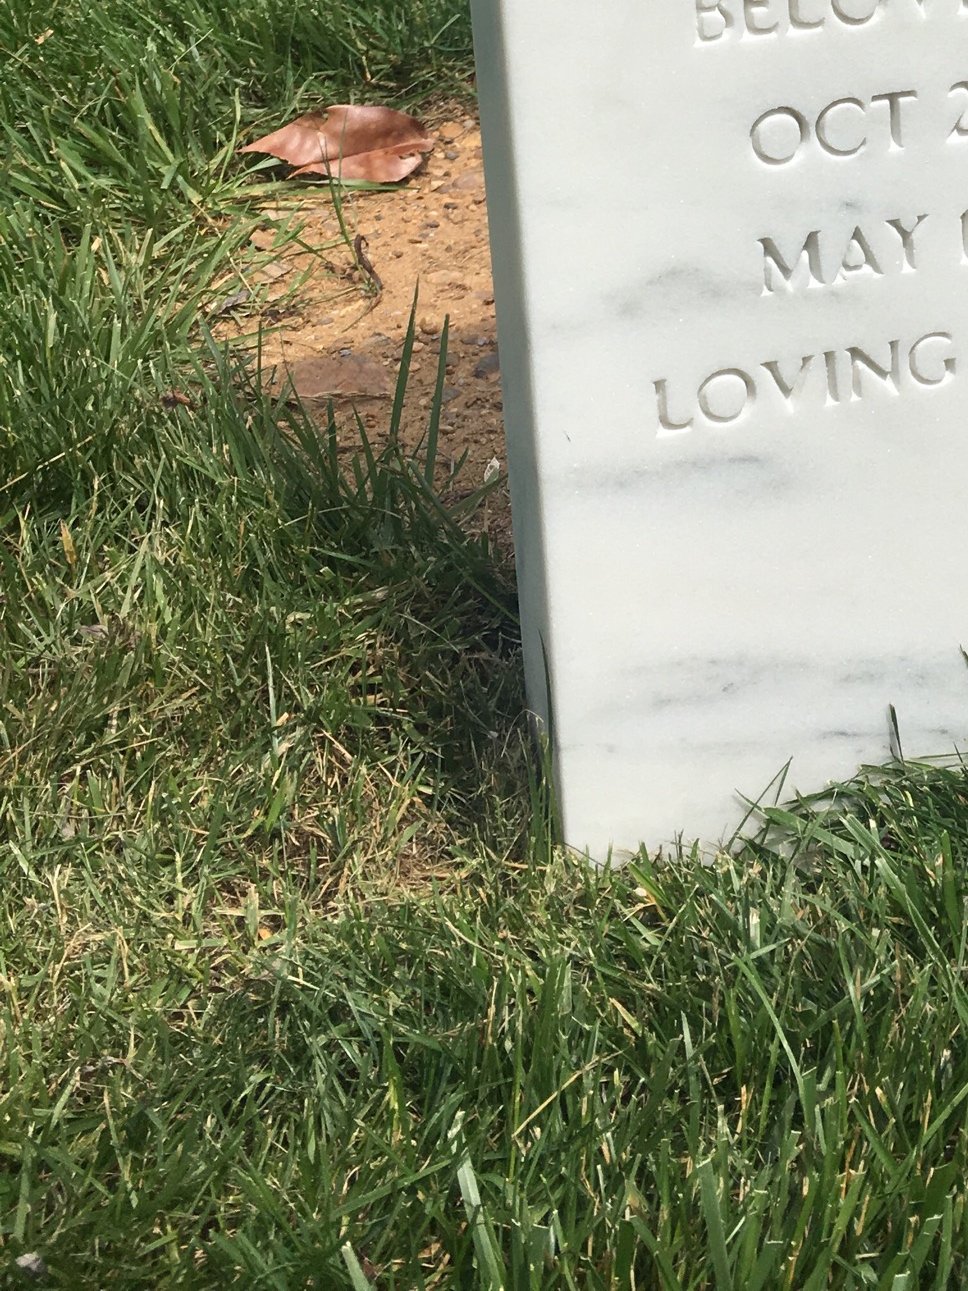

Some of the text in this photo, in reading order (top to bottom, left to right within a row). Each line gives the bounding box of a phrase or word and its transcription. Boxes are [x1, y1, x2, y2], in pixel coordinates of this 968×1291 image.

[749, 90, 918, 167] OCT
[756, 213, 930, 297] MAY
[652, 331, 957, 439] LOVING
